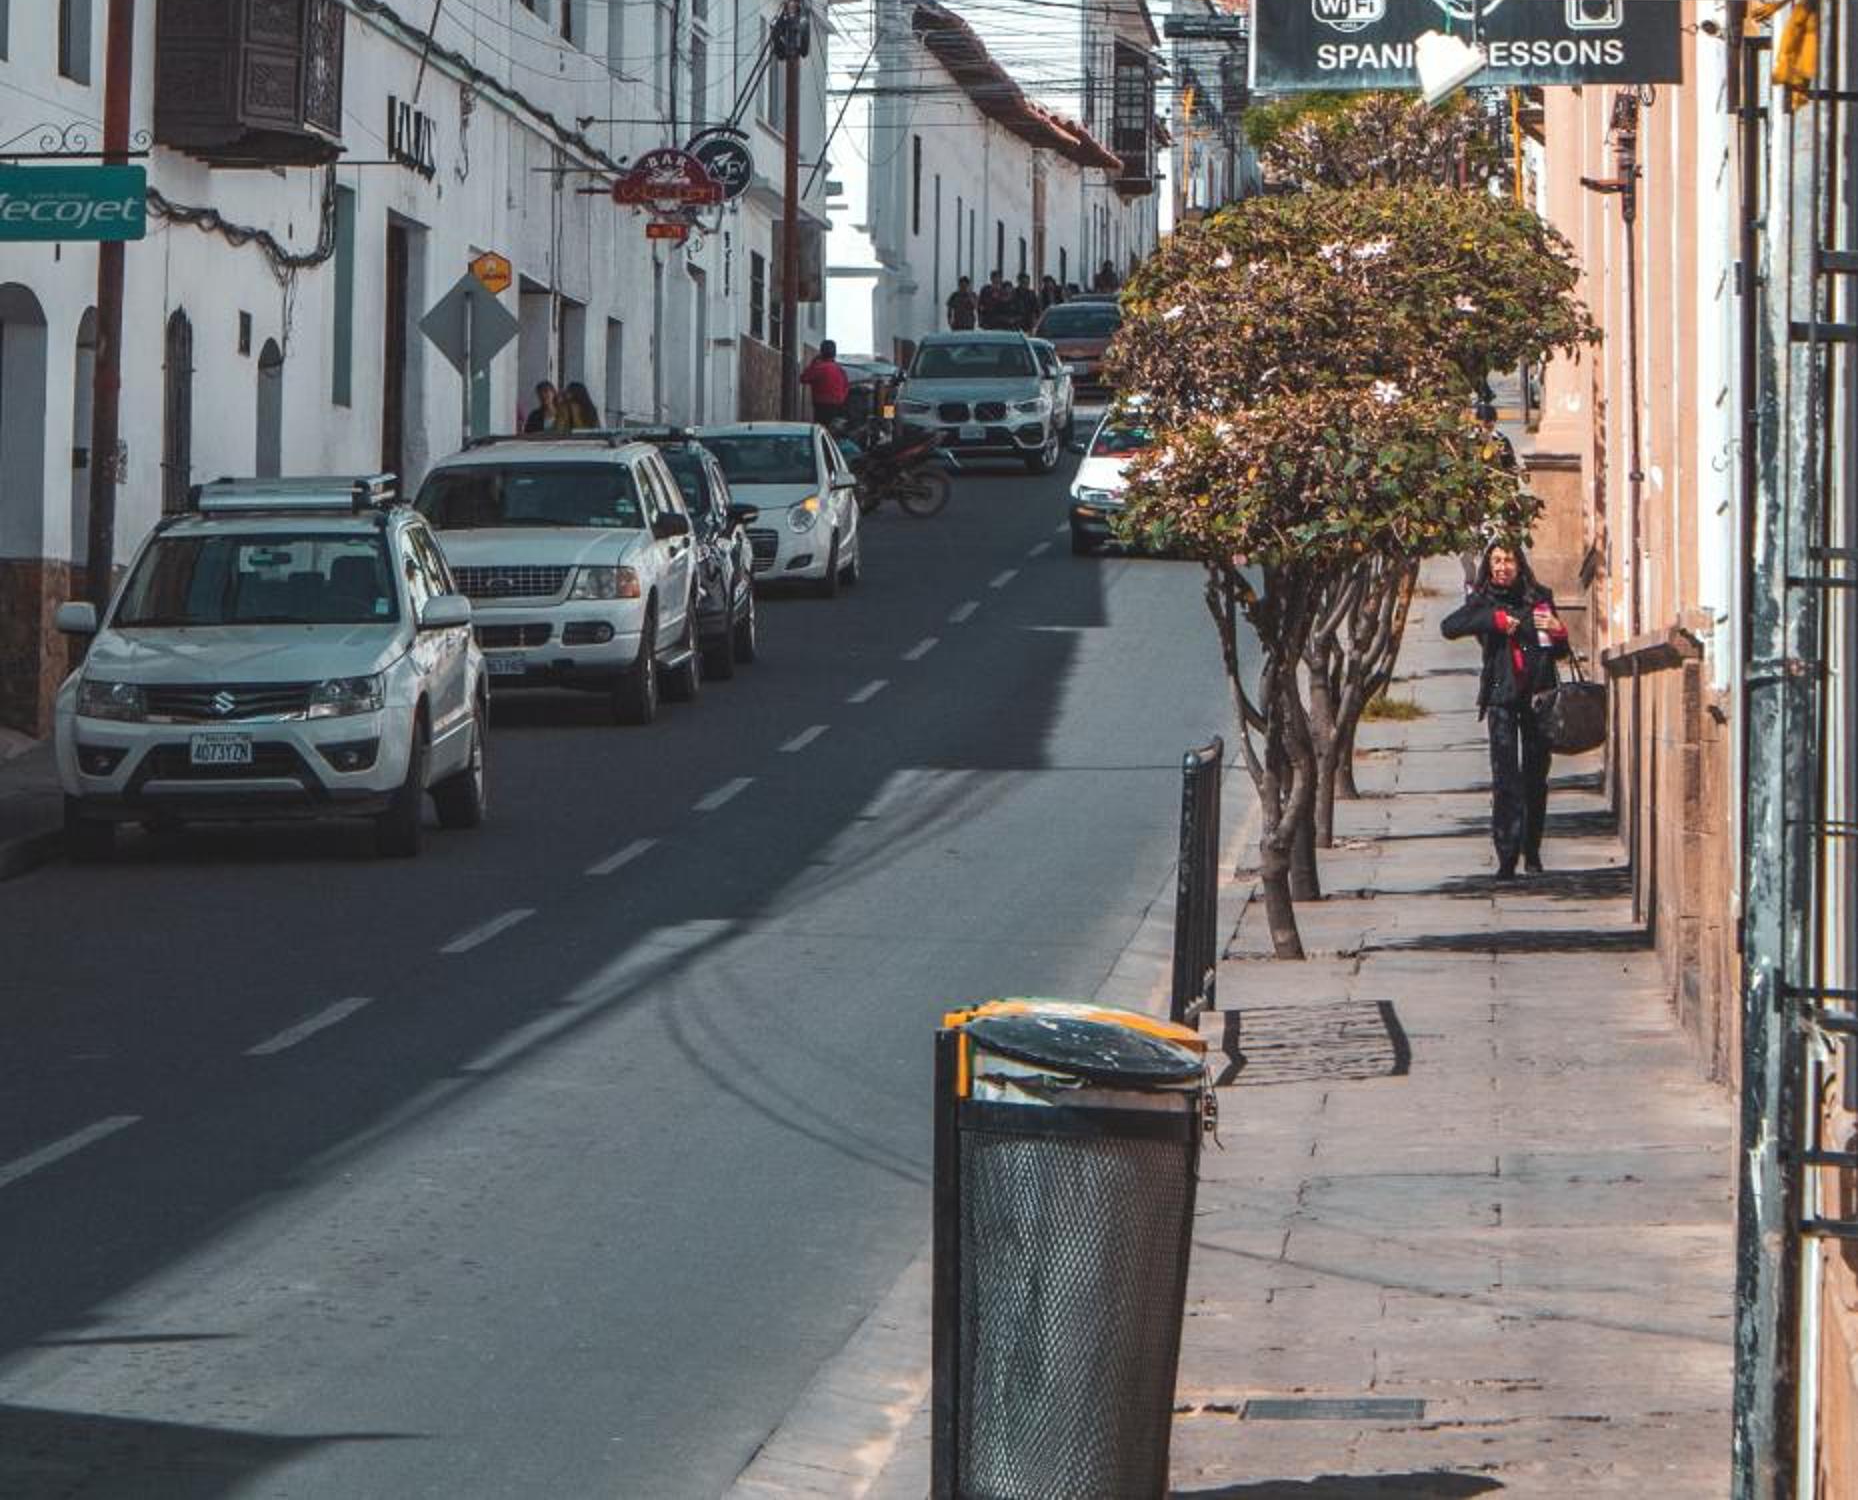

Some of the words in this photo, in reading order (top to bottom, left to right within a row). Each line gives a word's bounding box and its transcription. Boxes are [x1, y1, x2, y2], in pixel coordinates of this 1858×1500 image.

[1317, 43, 1414, 70] SPANI
[1488, 40, 1625, 67] ESSONS
[647, 153, 687, 168] BAR
